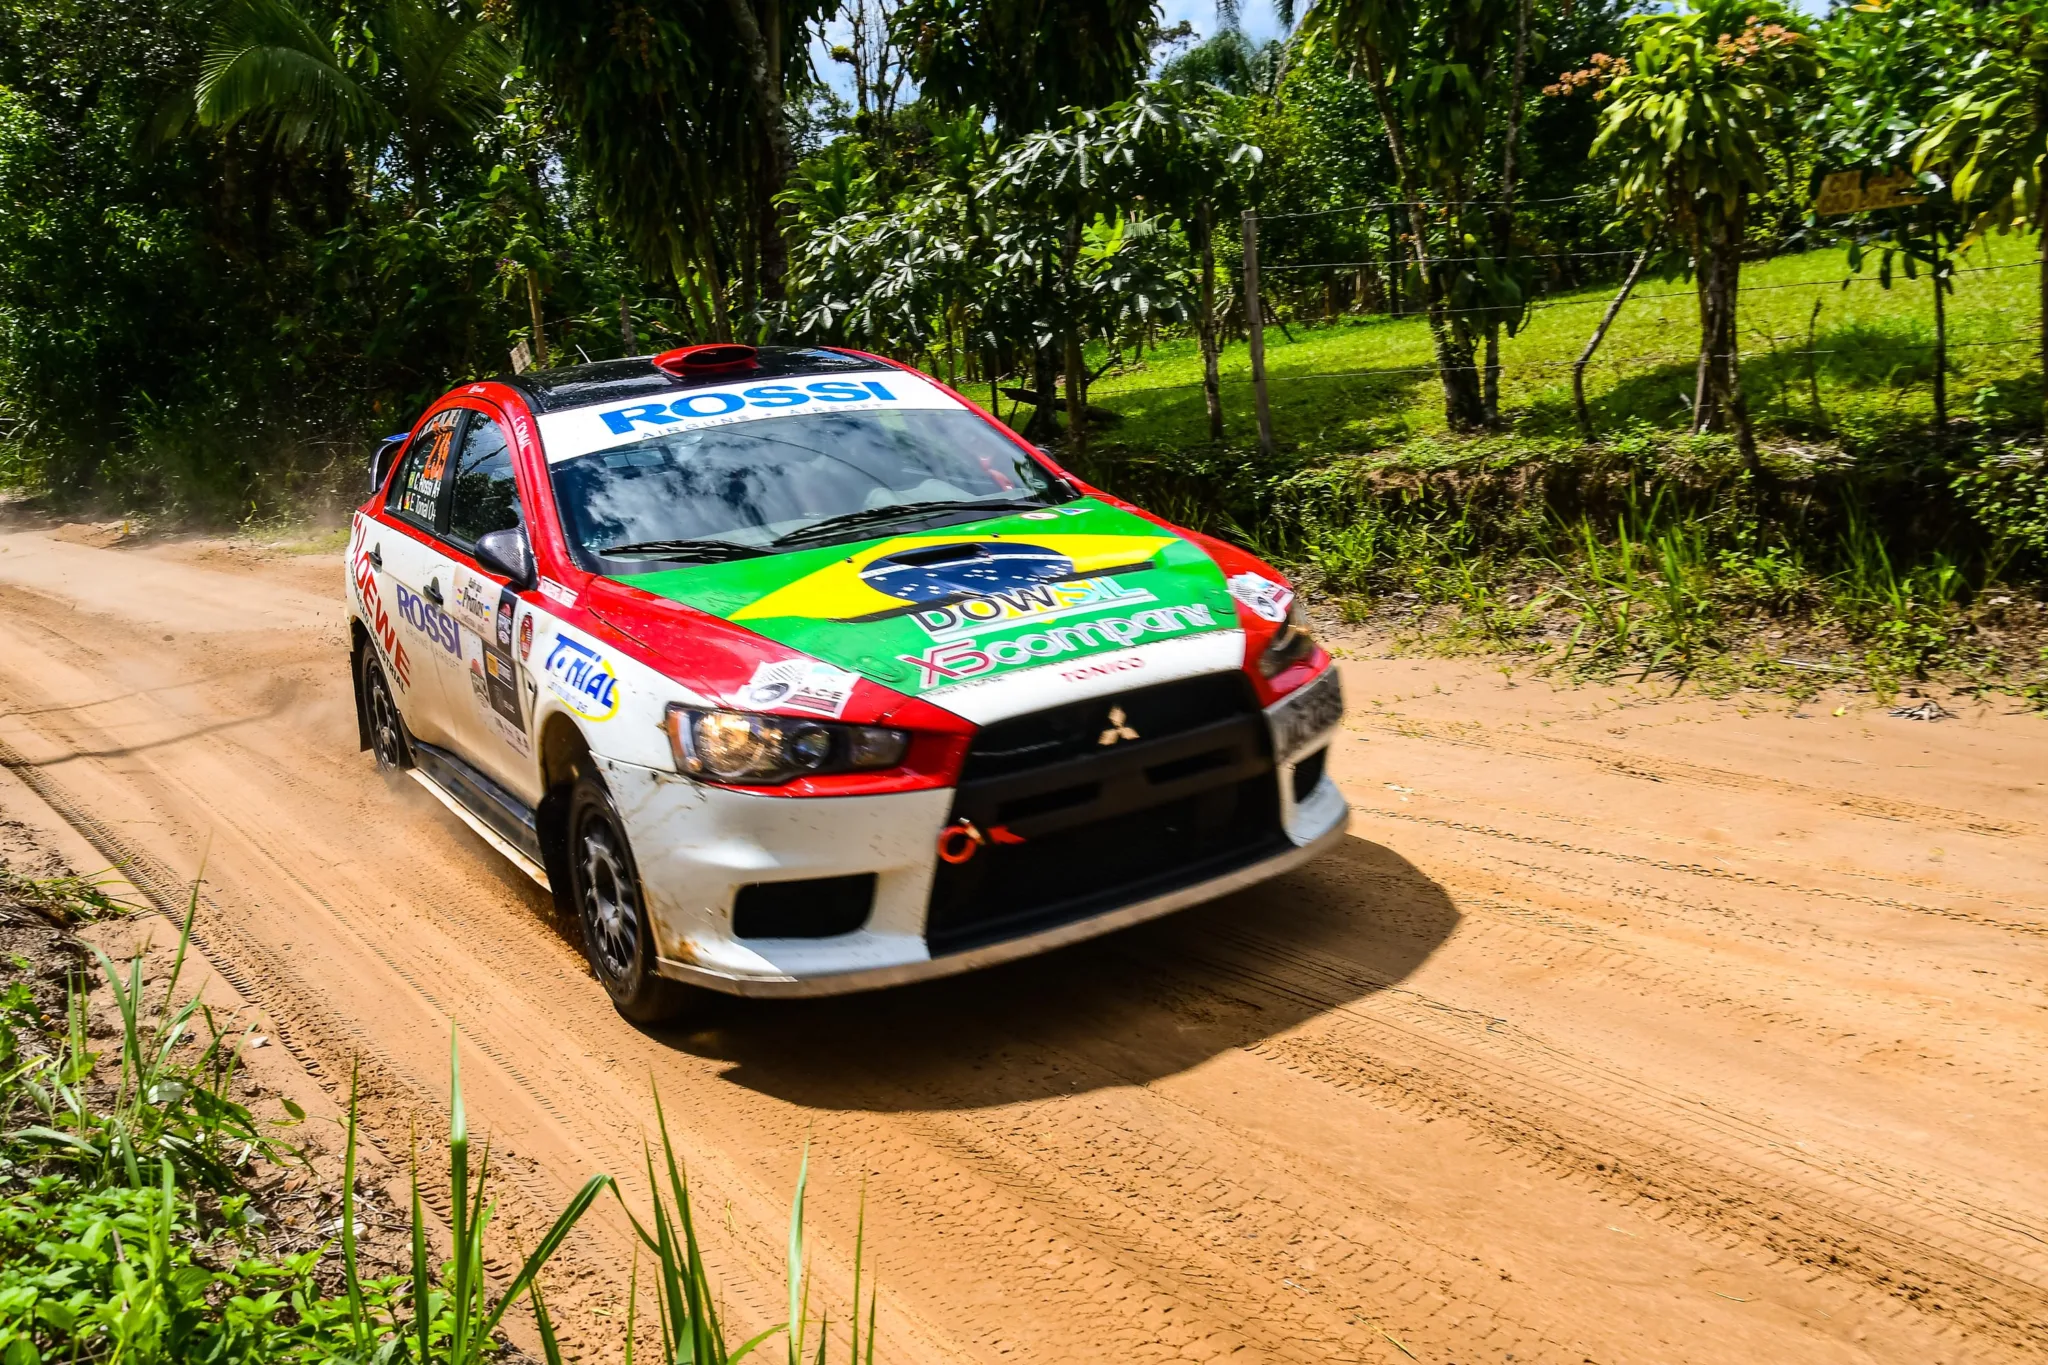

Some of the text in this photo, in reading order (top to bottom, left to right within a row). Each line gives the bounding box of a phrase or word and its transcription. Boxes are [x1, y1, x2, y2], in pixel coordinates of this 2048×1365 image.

[599, 381, 898, 435] ROSSI
[642, 403, 884, 440] AIRGUNS AIRSOFT
[396, 584, 463, 661] ROSSI
[908, 576, 1146, 634] DOWSIL
